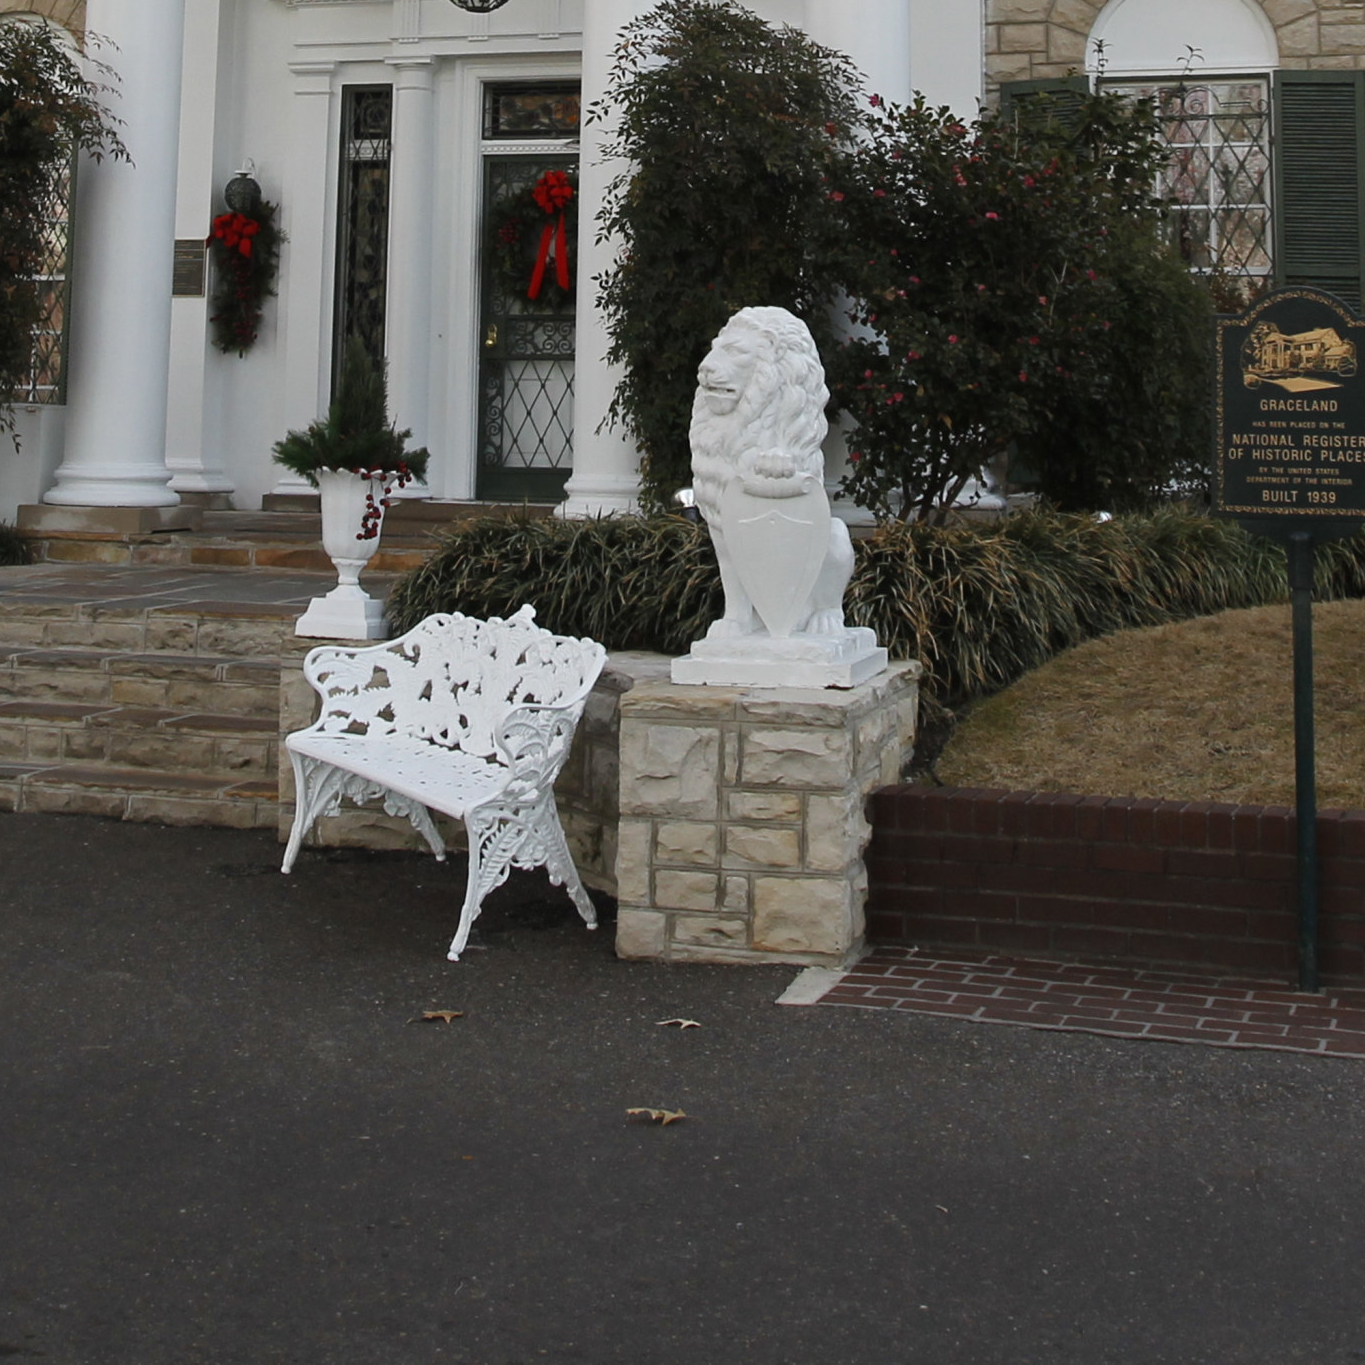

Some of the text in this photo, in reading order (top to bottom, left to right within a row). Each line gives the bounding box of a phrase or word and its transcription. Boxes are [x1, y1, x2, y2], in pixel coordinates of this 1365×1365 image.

[1260, 400, 1337, 411] GRACELAND
[1233, 434, 1365, 447] NATIONAL REGISTER
[1229, 448, 1243, 459] OF
[1253, 449, 1312, 461] HISTORIC
[1263, 491, 1336, 503] BUILT 1939
